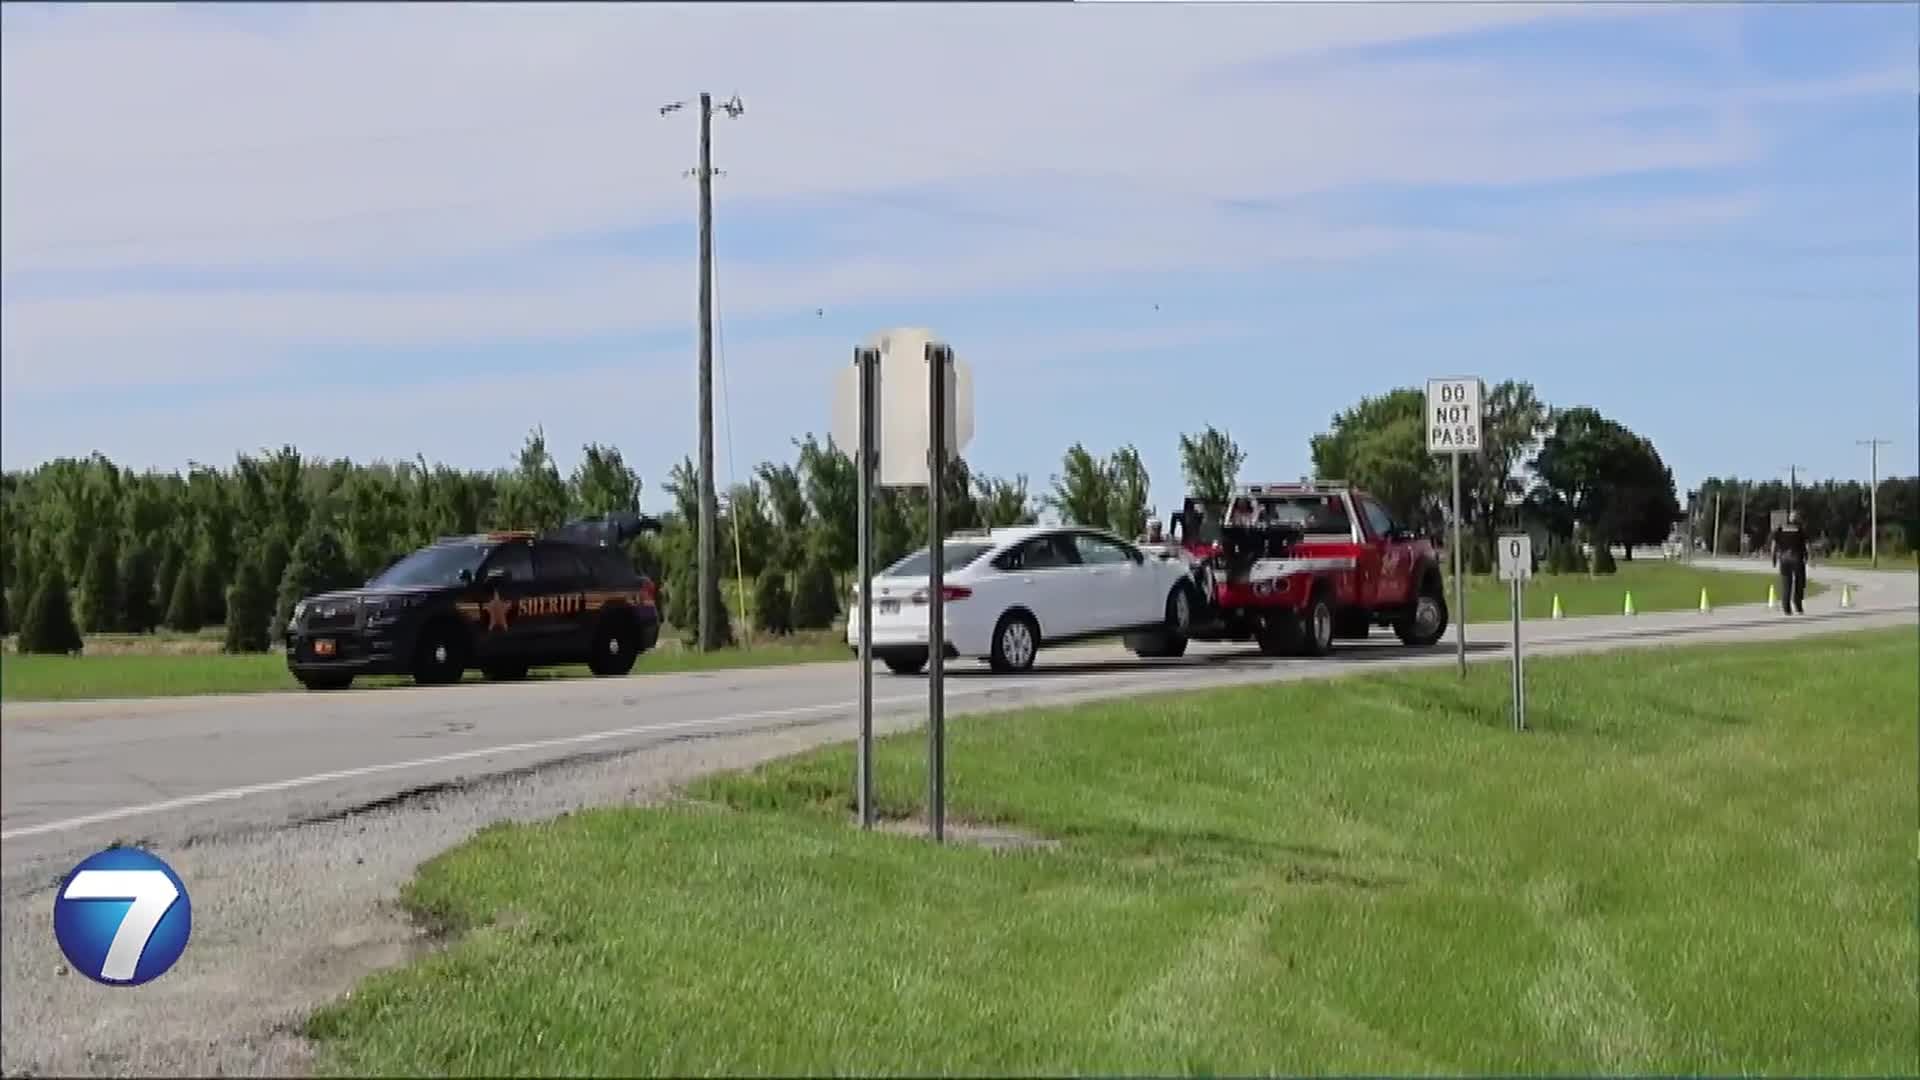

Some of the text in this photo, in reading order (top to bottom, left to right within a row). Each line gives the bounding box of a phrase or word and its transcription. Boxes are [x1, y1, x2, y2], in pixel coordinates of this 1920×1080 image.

[1442, 384, 1465, 403] DO
[1436, 405, 1469, 424] NOT
[1432, 426, 1477, 445] PASS
[518, 593, 582, 616] SHERIFF
